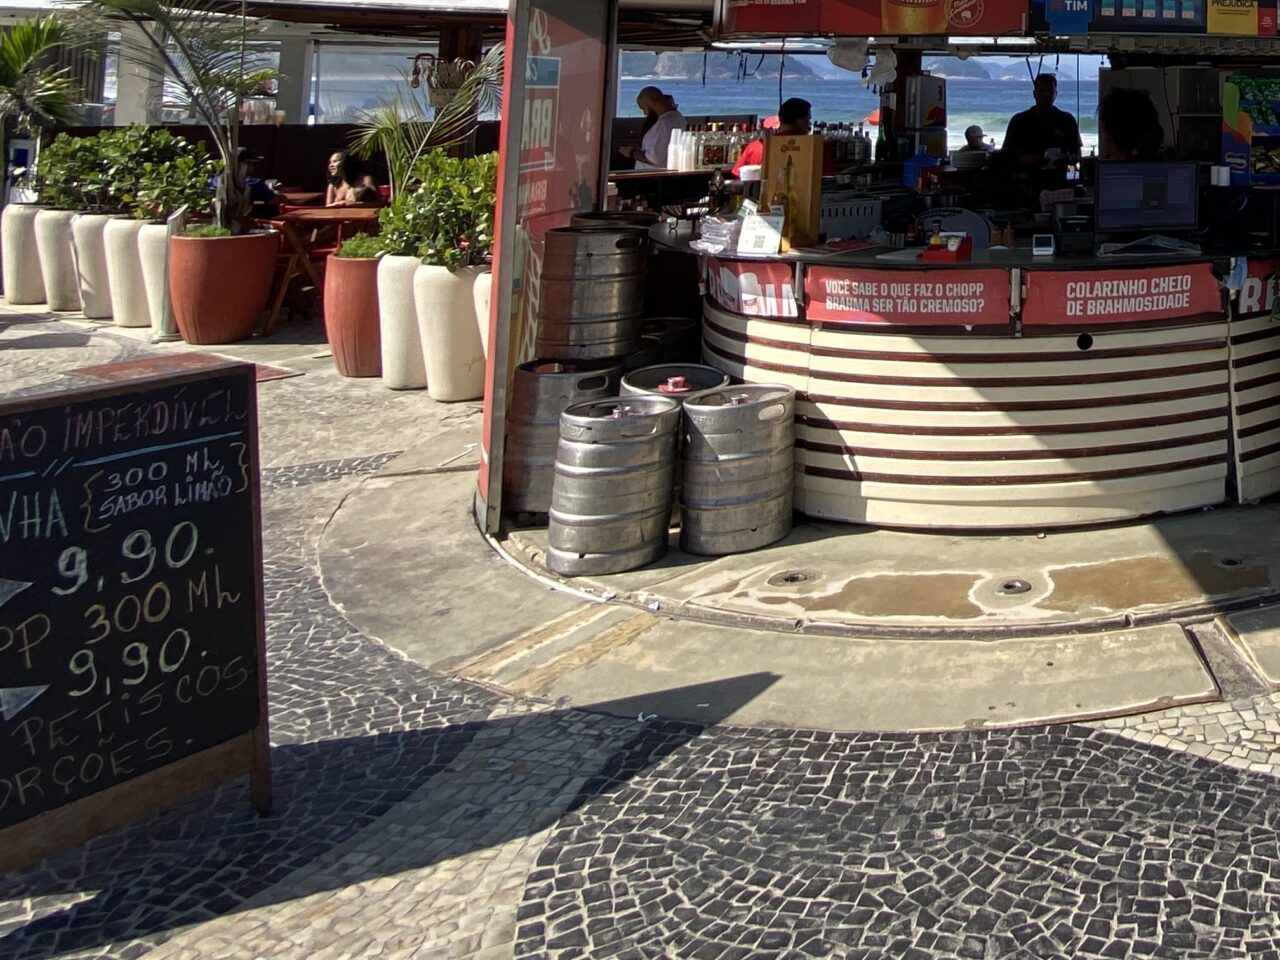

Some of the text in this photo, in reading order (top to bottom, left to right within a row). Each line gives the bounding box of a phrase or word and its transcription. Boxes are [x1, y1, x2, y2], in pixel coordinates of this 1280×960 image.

[1064, 0, 1088, 11] TIM
[825, 279, 984, 298] VOCÊ SABE O QUE FAZ O CHOPP
[1066, 275, 1192, 298] COLARINHO CHEIO
[825, 296, 985, 313] BRAHMA SER TÃO CREMOSO?
[1066, 293, 1190, 315] DE BRAHMOSIDADE
[104, 461, 168, 492] 300
[98, 484, 168, 520] SABOR
[84, 581, 171, 644] 300
